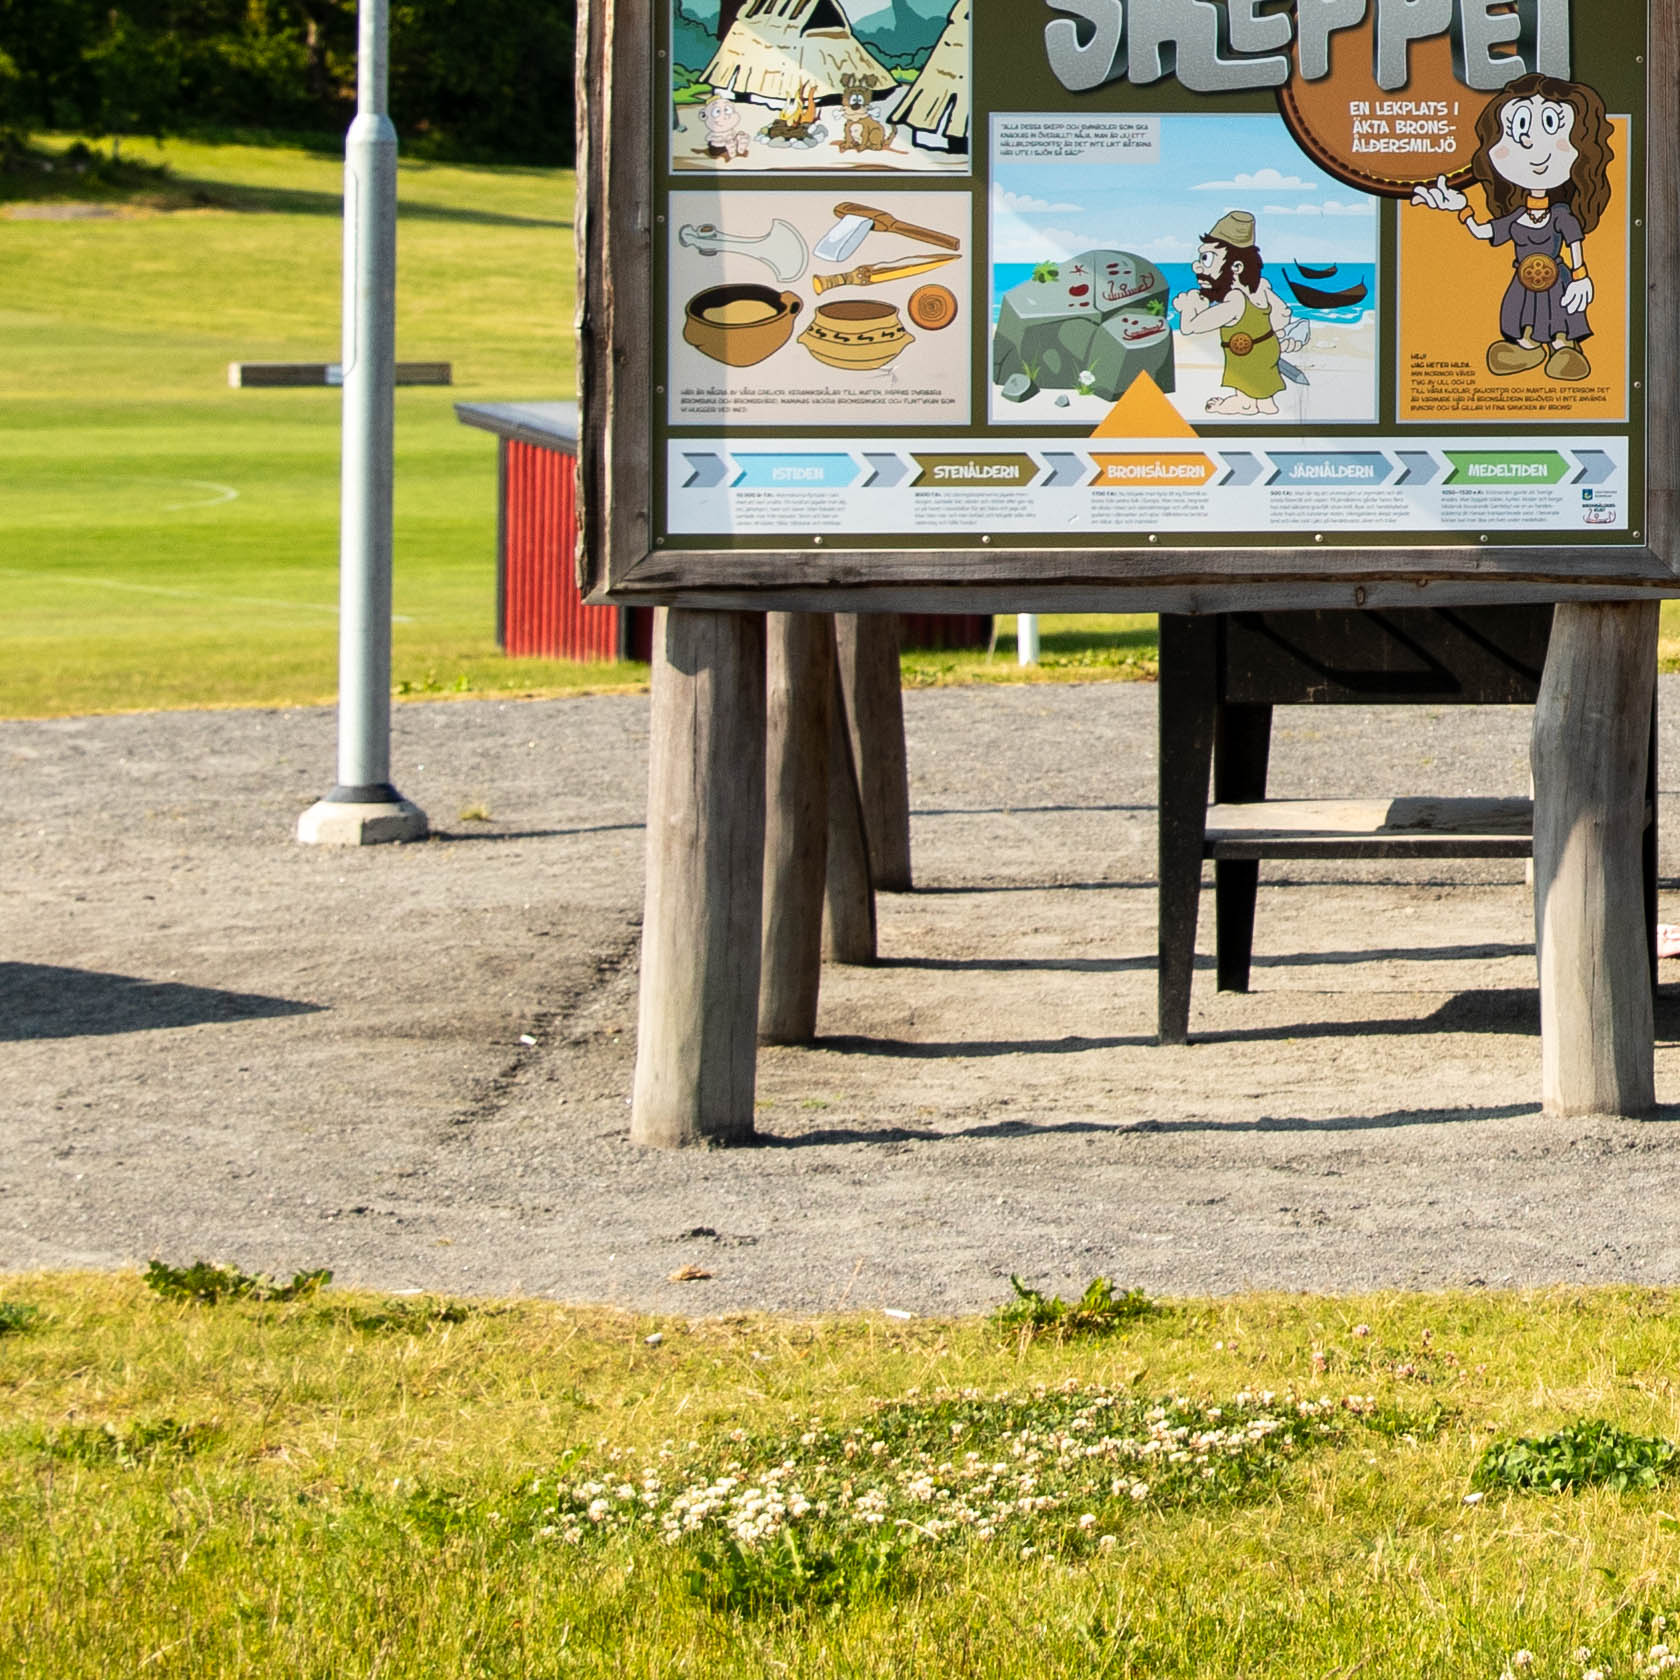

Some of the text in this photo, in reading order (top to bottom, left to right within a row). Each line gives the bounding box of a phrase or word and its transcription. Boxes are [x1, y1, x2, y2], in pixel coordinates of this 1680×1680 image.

[1349, 102, 1459, 116] EN LEKPLATS I
[1353, 117, 1457, 134] ÄKTA BRONS-
[1352, 134, 1457, 153] ÅLDERSMILJÖ
[771, 466, 825, 481] ISTIDEN
[933, 463, 1021, 479] STENÅLDERN
[1107, 462, 1205, 479] BRONSÅLDERN
[1289, 463, 1375, 478] JÄRNÅLDERN
[1468, 463, 1548, 477] MEDELTIDEN
